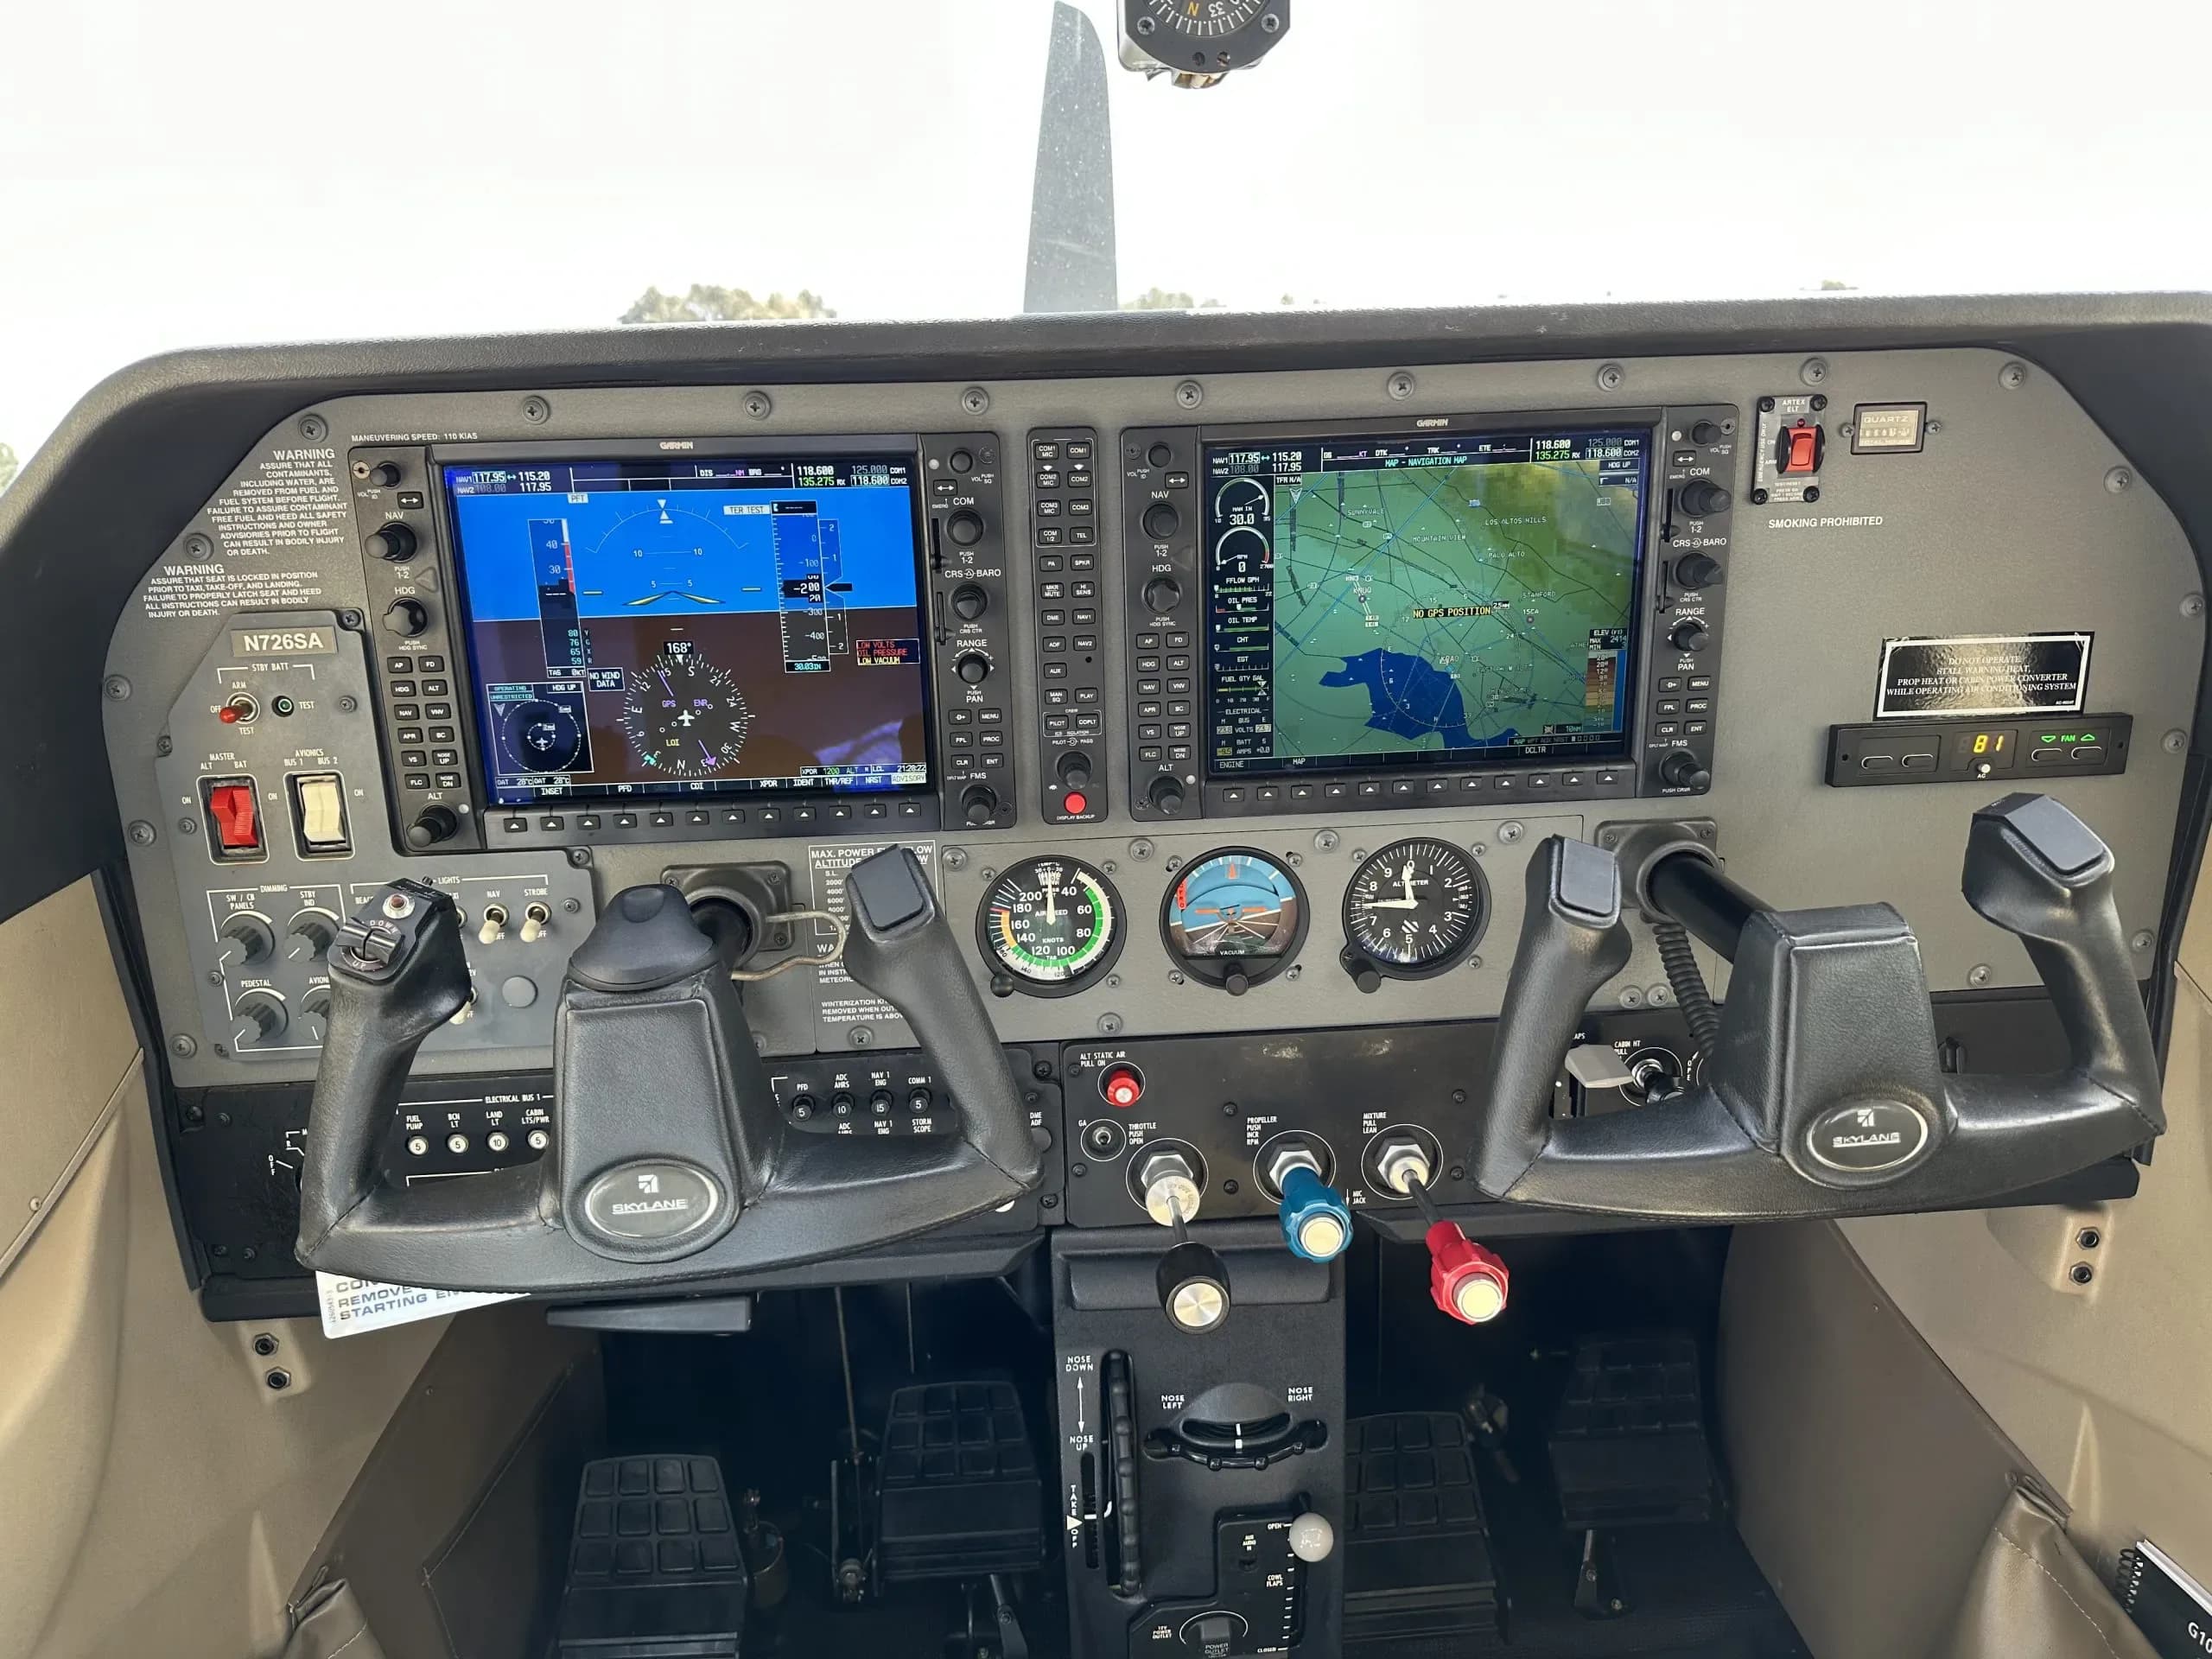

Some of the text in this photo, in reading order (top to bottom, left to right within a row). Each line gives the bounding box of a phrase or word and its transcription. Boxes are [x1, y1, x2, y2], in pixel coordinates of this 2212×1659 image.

[1187, 2, 1199, 16] N
[1535, 440, 1571, 449] 118.600
[273, 448, 335, 461] WARNING
[1272, 453, 1301, 461] 115.20
[1535, 450, 1570, 460] 135.275
[1408, 457, 1452, 466] NAVIGATION
[797, 467, 834, 475] 118.600
[1272, 463, 1301, 472] 117.95
[1689, 467, 1710, 476] COM
[474, 471, 550, 482] 117.95 115.20
[798, 477, 835, 486] 135.275
[852, 477, 888, 486] 118.600
[520, 482, 551, 492] 117.95
[1229, 513, 1255, 525] 30.0
[1769, 516, 1883, 529] SMOKING PROHIBITED
[164, 564, 224, 575] WARNING
[1413, 607, 1491, 618] NO GPS POSITION
[244, 632, 323, 651] N726SA
[2017, 673, 2068, 682] CONVERTER
[1915, 686, 1963, 695] OPERATING
[1525, 746, 1546, 754] DCLTR
[209, 753, 235, 761] MASTER
[838, 849, 874, 857] POWER
[1384, 868, 1393, 878] 9
[438, 876, 461, 885] LIGHTS
[486, 890, 500, 899] NAV
[524, 887, 549, 897] STROBE
[1061, 887, 1077, 896] 40
[1019, 892, 1042, 901] 200
[1013, 904, 1032, 912] 180
[1077, 906, 1091, 914] 60
[1011, 920, 1030, 929] 160
[1077, 928, 1090, 938] 80
[1017, 933, 1035, 943] 140
[1405, 934, 1413, 944] 5
[1032, 946, 1050, 955] 120
[1057, 946, 1076, 956] 100
[1247, 1116, 1277, 1124] PROPELLER
[1363, 1111, 1387, 1120] MIXTURE
[1128, 1122, 1156, 1130] THROTTLE
[1833, 1131, 1900, 1148] SKYLANE
[612, 1198, 688, 1214] SKYLANE
[340, 1294, 427, 1320] STARTING
[1065, 1363, 1093, 1372] DOWN
[1070, 1435, 1093, 1444] NOSE
[1076, 1443, 1088, 1452] UP
